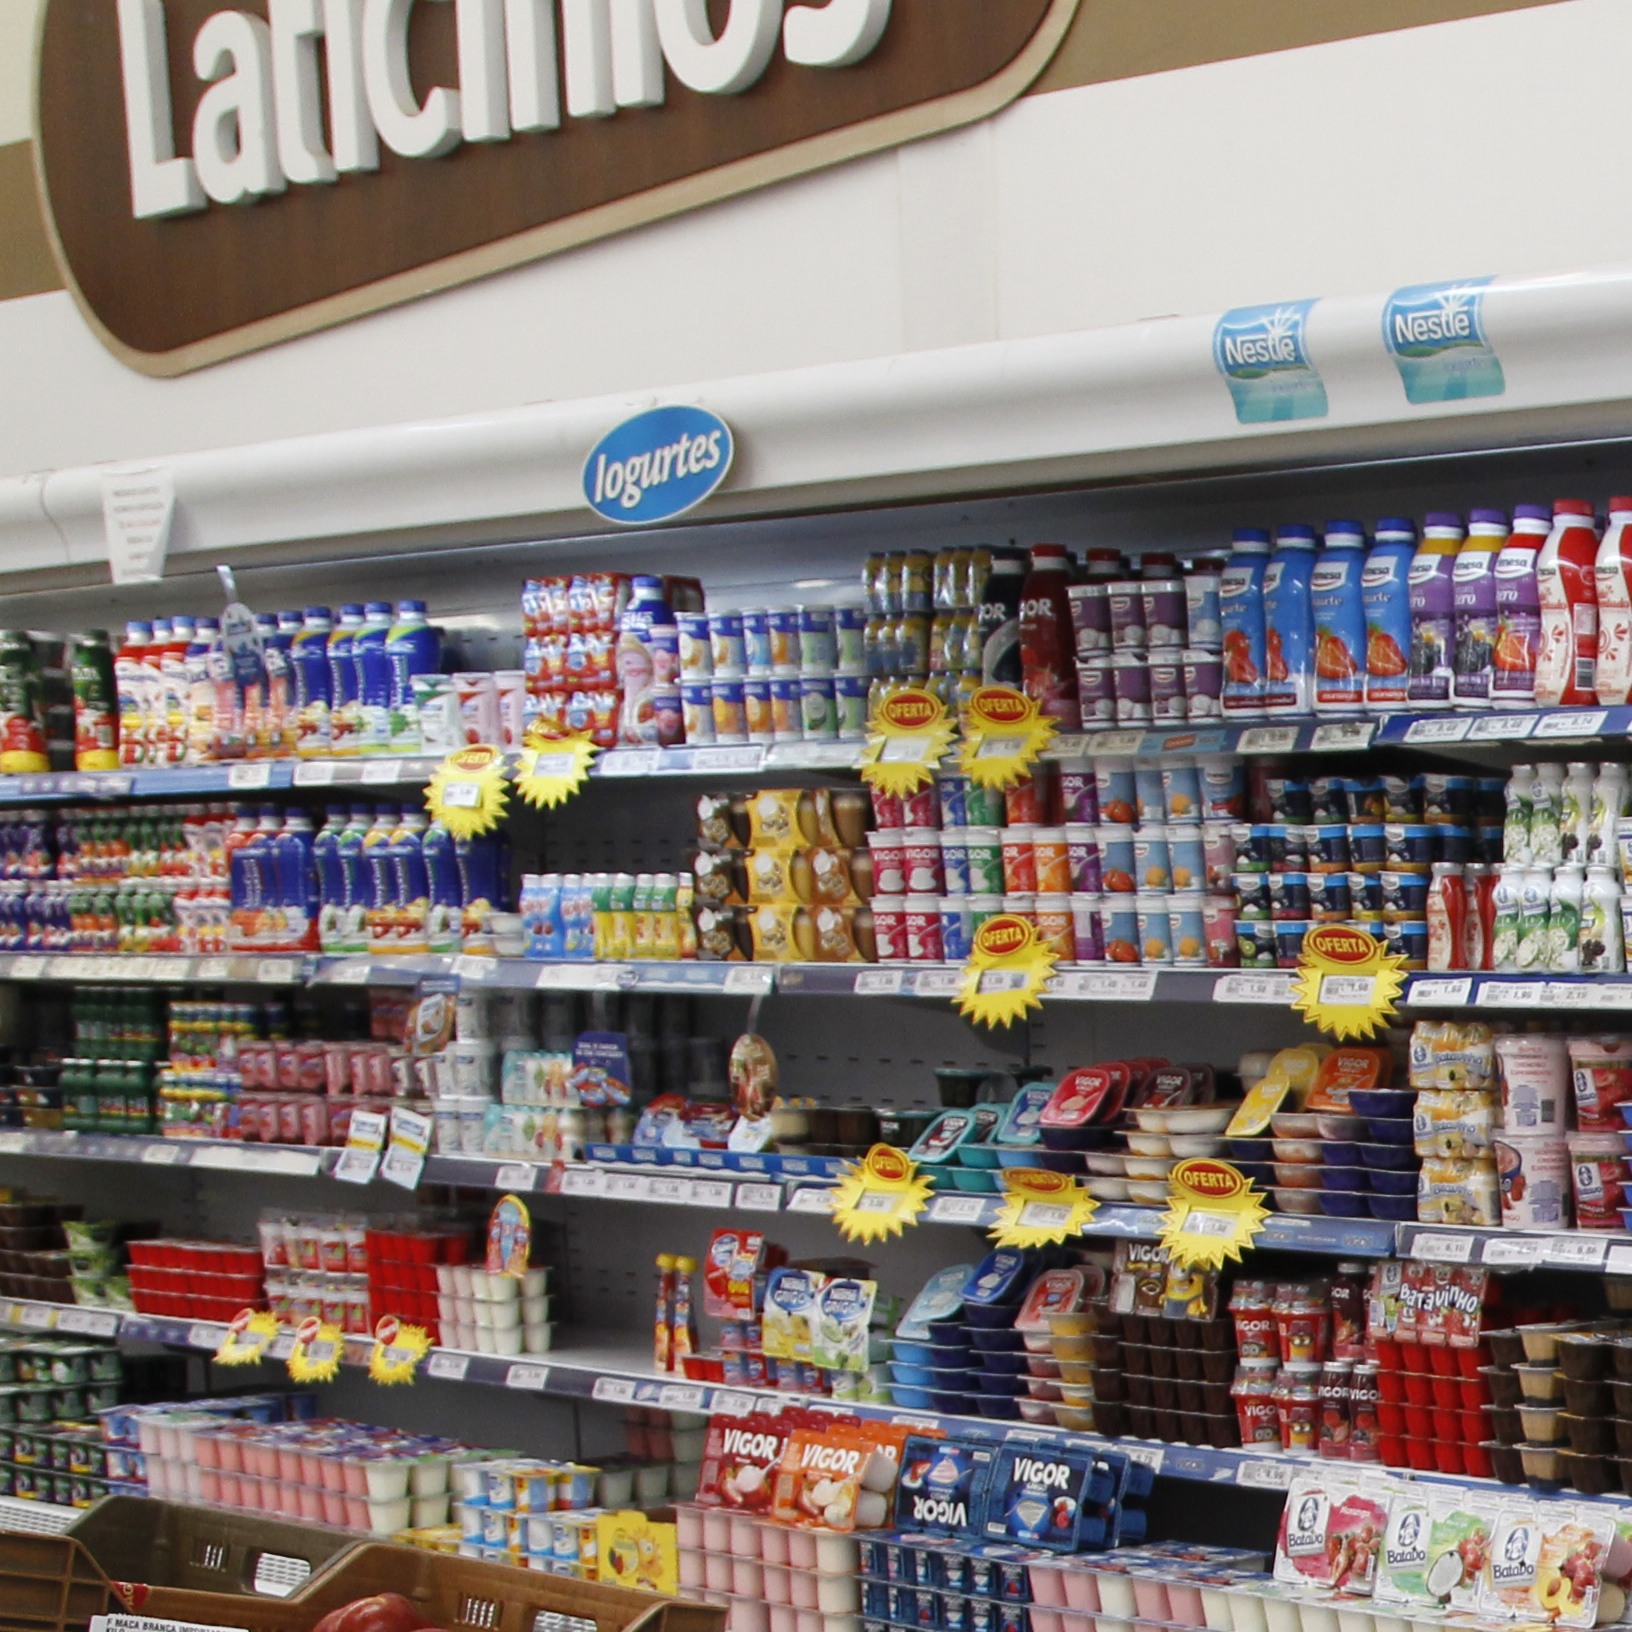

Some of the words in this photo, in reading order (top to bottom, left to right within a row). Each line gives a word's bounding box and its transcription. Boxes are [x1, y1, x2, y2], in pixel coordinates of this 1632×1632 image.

[594, 429, 722, 509] Iogurtes
[888, 702, 932, 718] OFERTA
[979, 698, 1024, 713] OFERTA
[983, 926, 1024, 946] OFERTA
[1316, 937, 1369, 953] OFERTA
[1338, 1058, 1369, 1068] VIGOR
[1075, 1076, 1102, 1086] VIGOR
[1156, 1075, 1183, 1086] VIGOR
[1184, 1170, 1235, 1188] OFERTA
[1129, 1243, 1171, 1264] VIGOR
[1244, 1405, 1276, 1416] VIGO
[723, 1428, 778, 1461] VIGOR
[801, 1443, 860, 1474] VIGOR
[1013, 1457, 1071, 1489] VIGOR
[913, 1496, 967, 1527] VIGOR
[1288, 1529, 1324, 1547] Batavo
[1387, 1546, 1426, 1564] Batavo
[1492, 1560, 1535, 1578] Batavo
[115, 1618, 140, 1630] MACA
[142, 1621, 177, 1632] BRANCA
